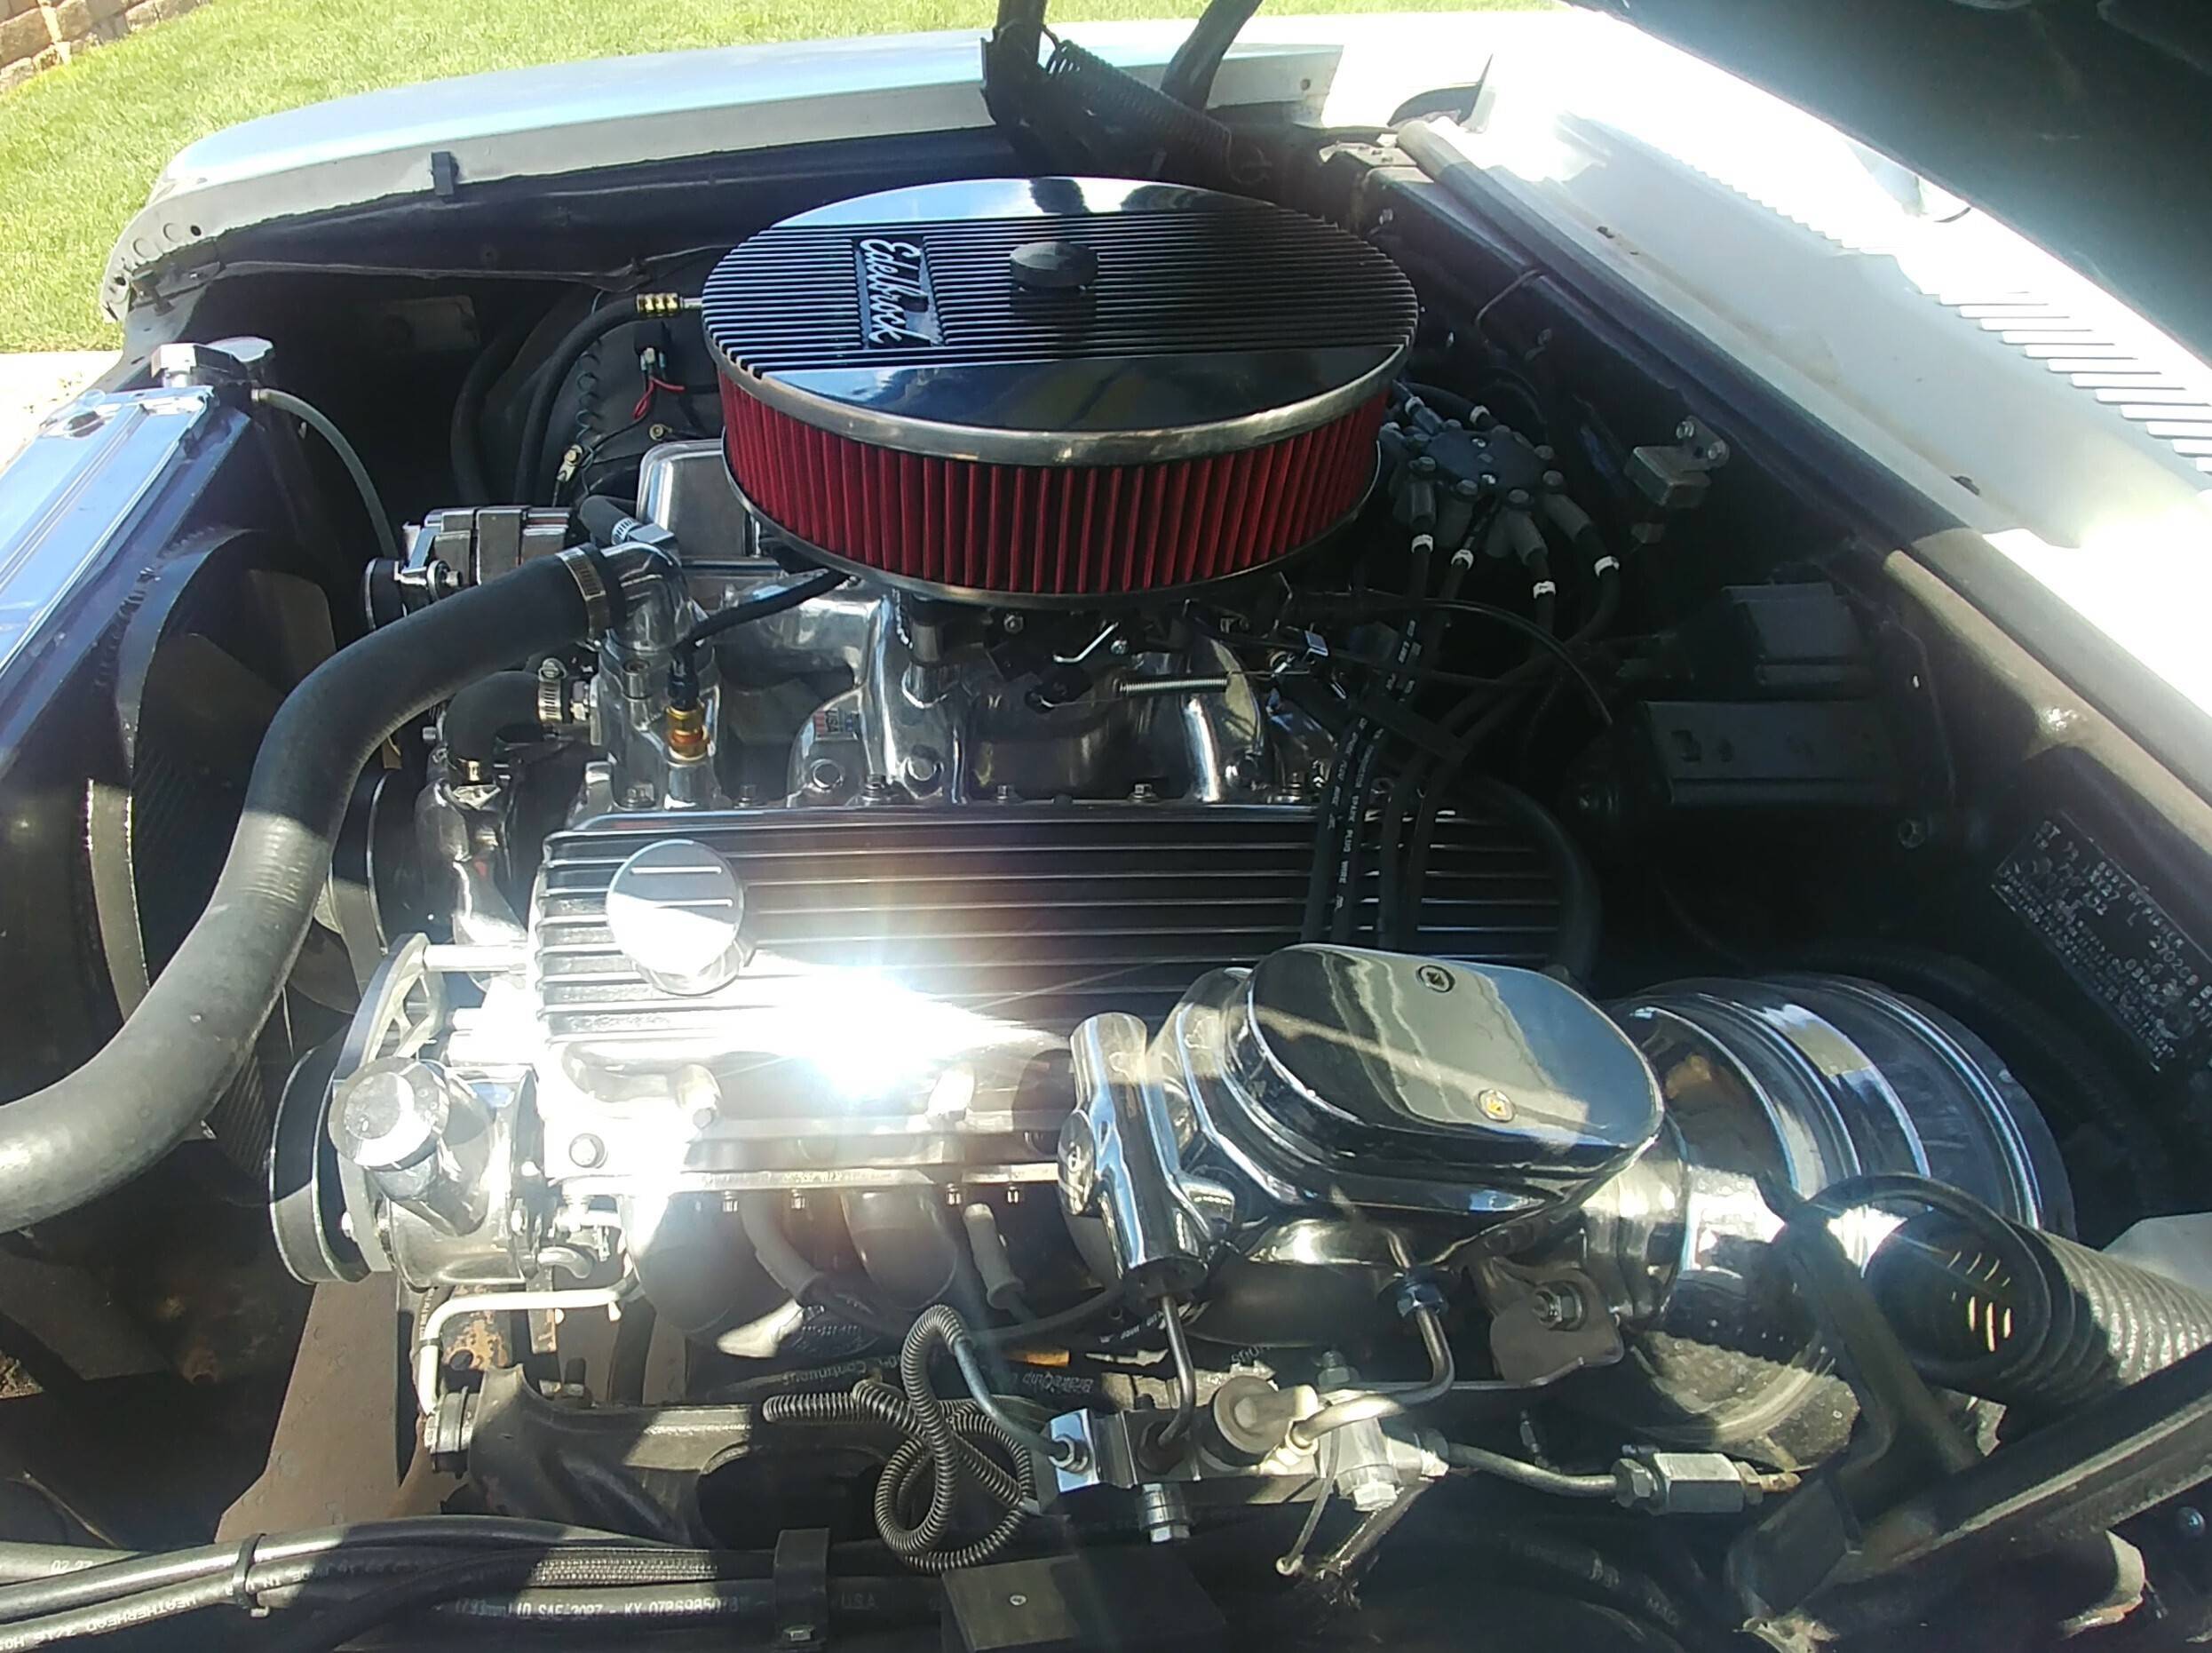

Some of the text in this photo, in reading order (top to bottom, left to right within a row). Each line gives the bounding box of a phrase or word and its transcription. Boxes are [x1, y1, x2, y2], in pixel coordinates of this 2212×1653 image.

[860, 238, 930, 344] Edelbrock
[1343, 829, 1353, 853] PLUG
[1338, 860, 1349, 883] WIRE
[85, 1594, 197, 1632] WEATHERHEAD
